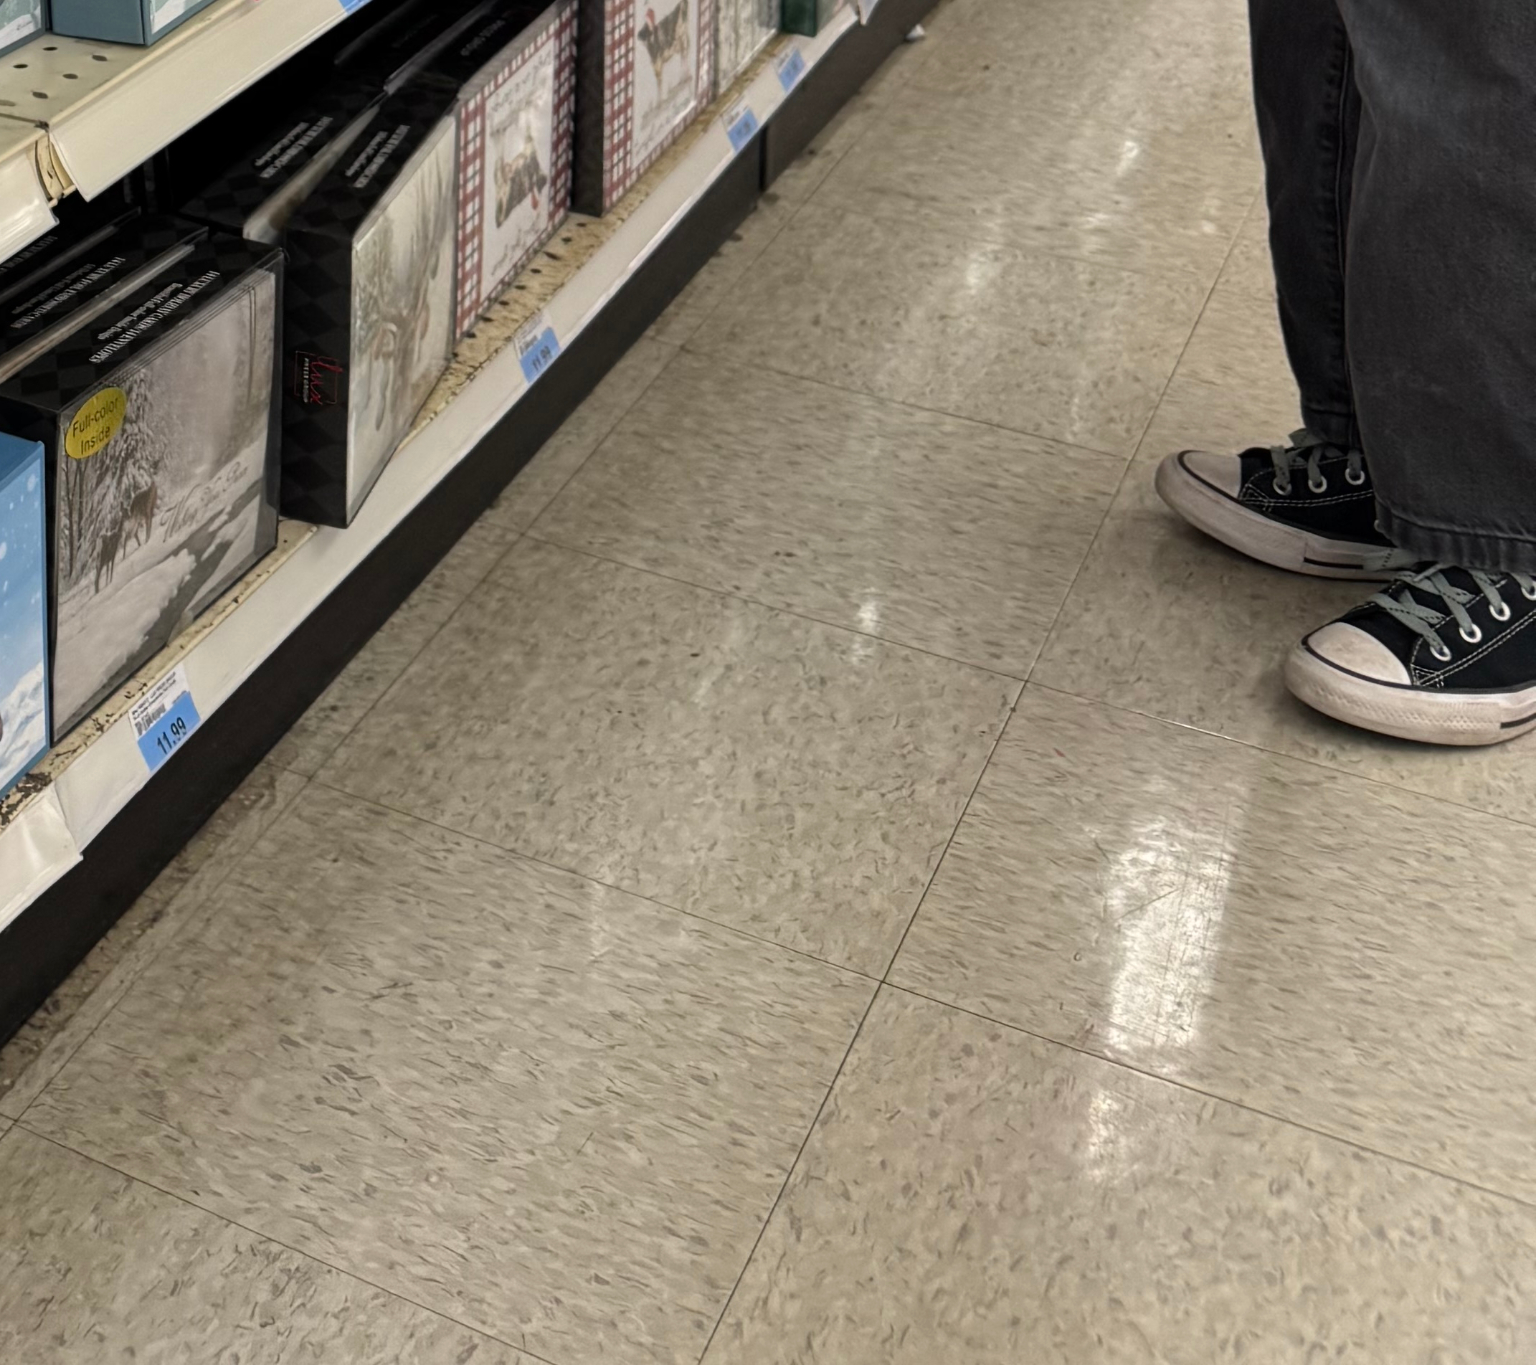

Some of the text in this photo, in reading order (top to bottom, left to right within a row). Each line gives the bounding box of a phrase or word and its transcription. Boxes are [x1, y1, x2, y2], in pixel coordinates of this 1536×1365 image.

[72, 397, 120, 438] Full-color
[80, 424, 111, 456] Inside
[156, 716, 187, 755] 11.99
